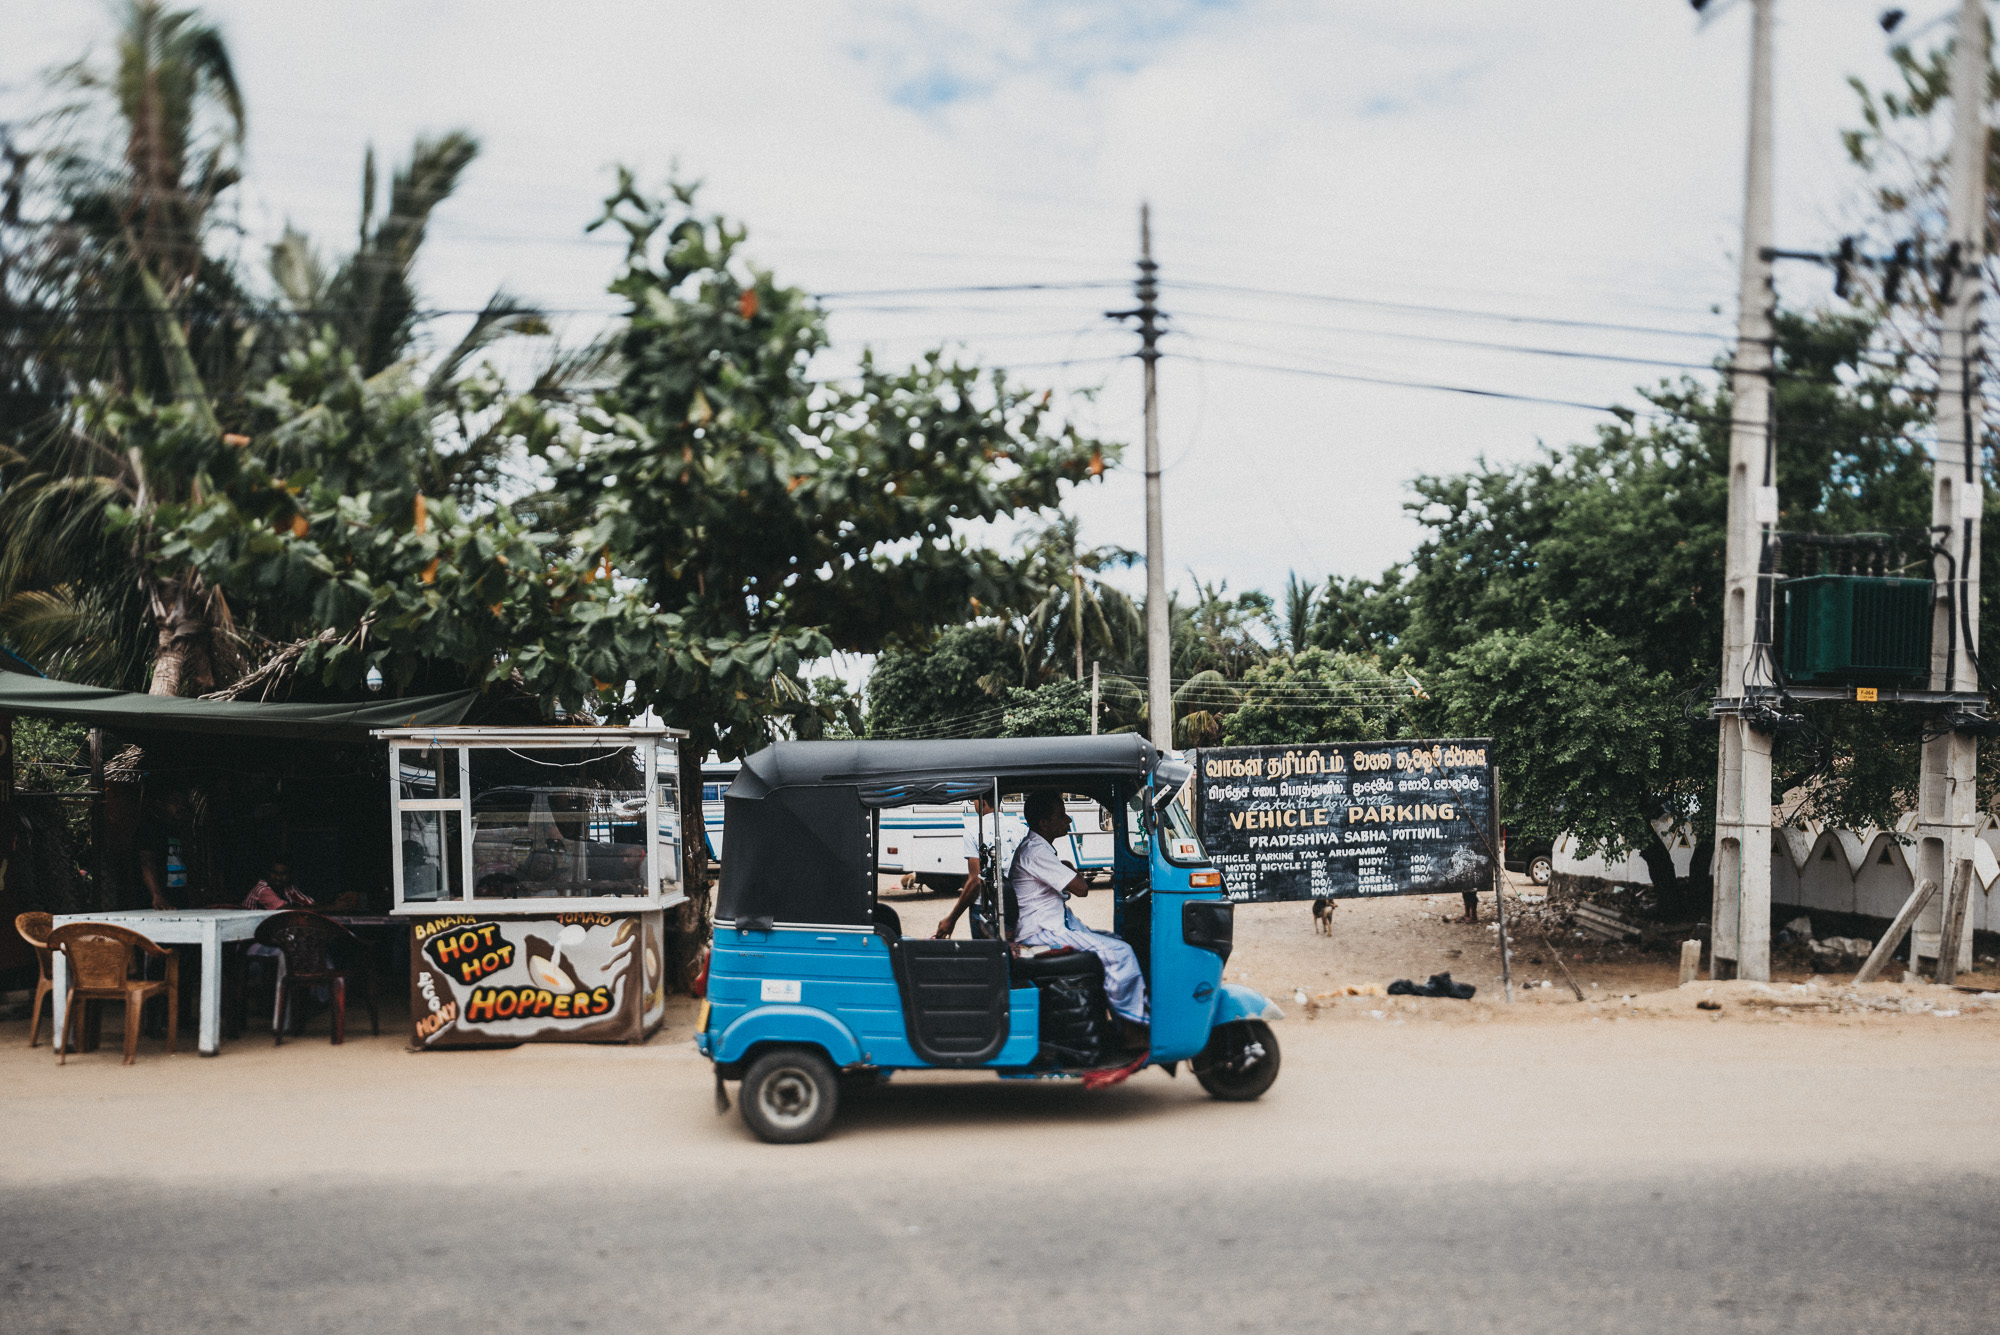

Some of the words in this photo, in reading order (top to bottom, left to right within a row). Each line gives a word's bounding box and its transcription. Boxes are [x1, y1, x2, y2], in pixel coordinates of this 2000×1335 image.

[1205, 758, 1264, 778] வாகன
[1353, 750, 1392, 771] වාහන
[1208, 784, 1250, 802] பிரதேச
[1229, 808, 1329, 830] VEHICLE
[1348, 803, 1461, 824] PARKING,
[1249, 831, 1339, 849] PRADESHIYA
[1344, 830, 1390, 843] SABHA,
[1392, 827, 1448, 841] POTTUVIL.
[1209, 854, 1250, 865] VEHICLE
[1255, 852, 1294, 862] PARKING
[1328, 846, 1388, 858] ARUGAMBAY
[1225, 863, 1257, 872] MOTOR
[414, 913, 477, 940] BANANA
[556, 912, 612, 926] TOMATO
[435, 925, 497, 964] HOT
[461, 944, 513, 982] HOT
[417, 970, 442, 1011] EGG
[468, 986, 610, 1020] HOPPERS
[416, 1000, 457, 1039] HONY
